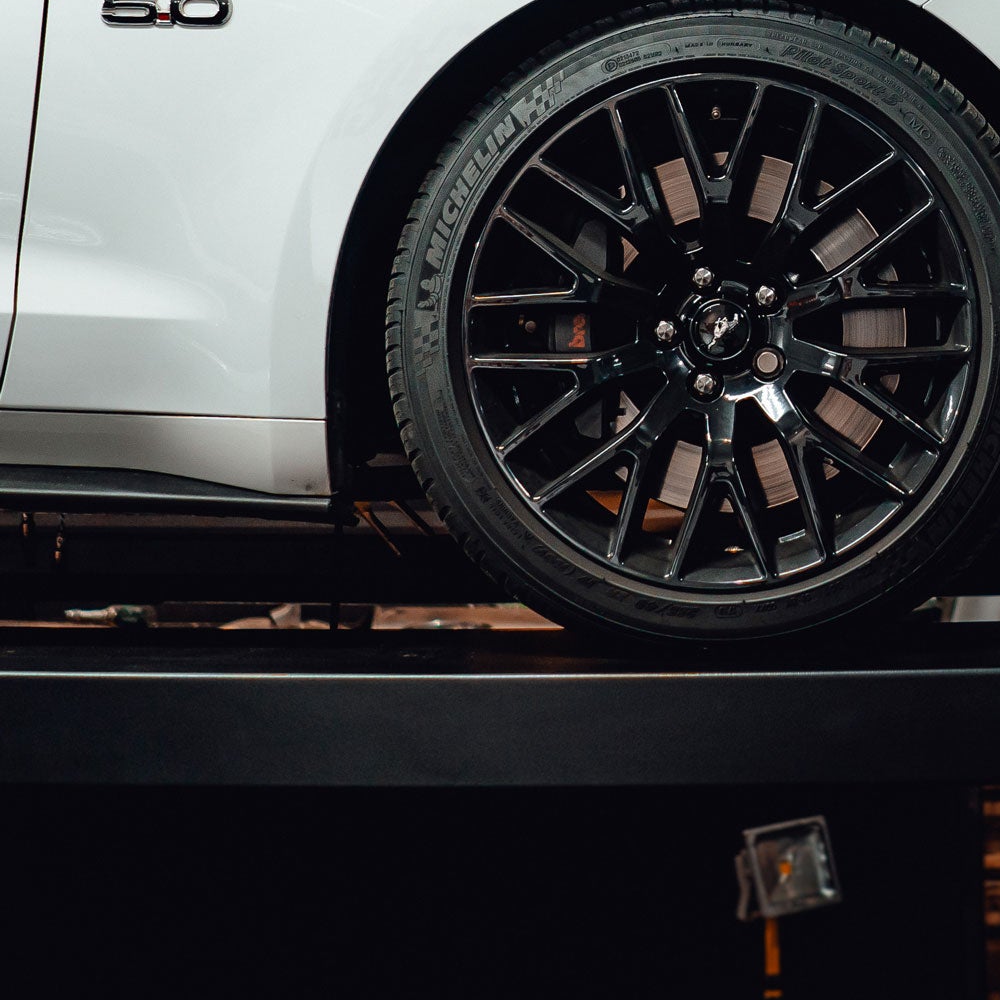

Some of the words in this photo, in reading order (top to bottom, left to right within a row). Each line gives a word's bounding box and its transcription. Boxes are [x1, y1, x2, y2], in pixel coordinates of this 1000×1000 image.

[779, 45, 832, 69] Pilot
[830, 63, 890, 96] Sport
[425, 114, 516, 270] MICHELIN
